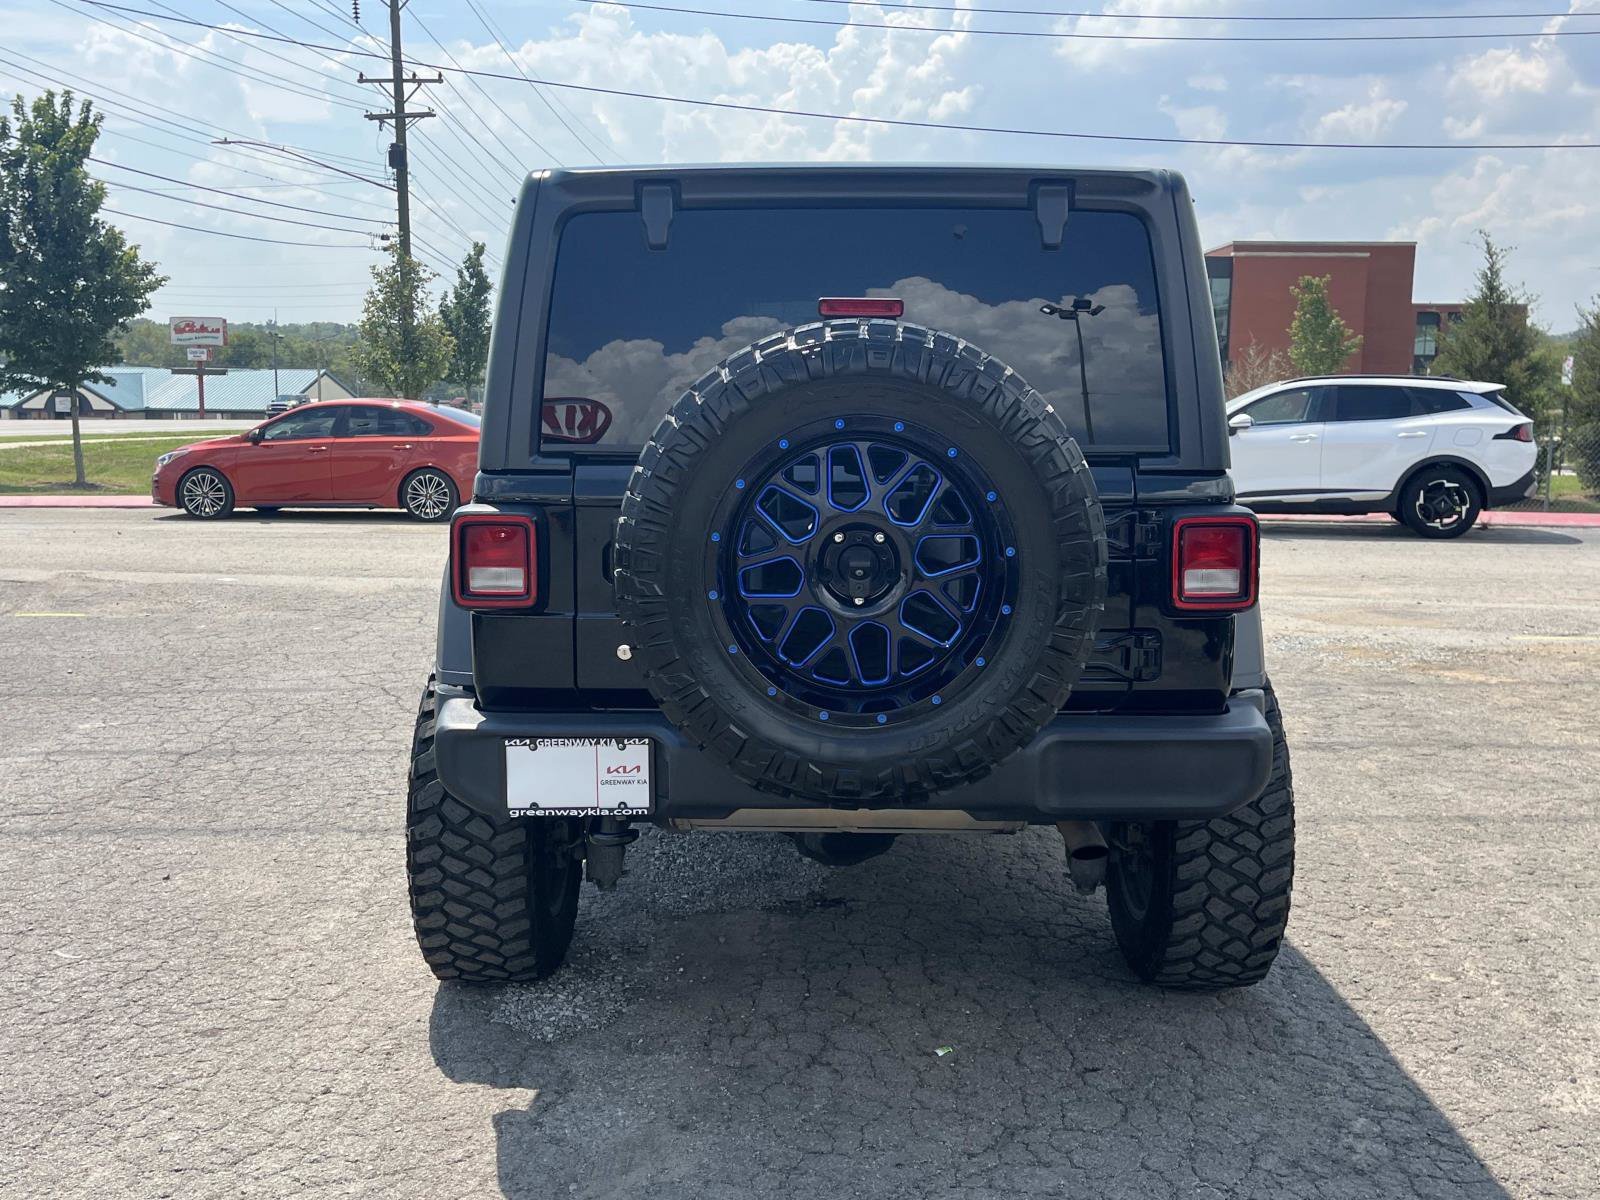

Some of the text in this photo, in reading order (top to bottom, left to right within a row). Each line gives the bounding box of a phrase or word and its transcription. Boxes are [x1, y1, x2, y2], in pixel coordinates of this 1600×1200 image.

[536, 738, 618, 748] GREENWAY KIA
[607, 765, 640, 774] KIA
[509, 808, 647, 817] greenwaykia.com
